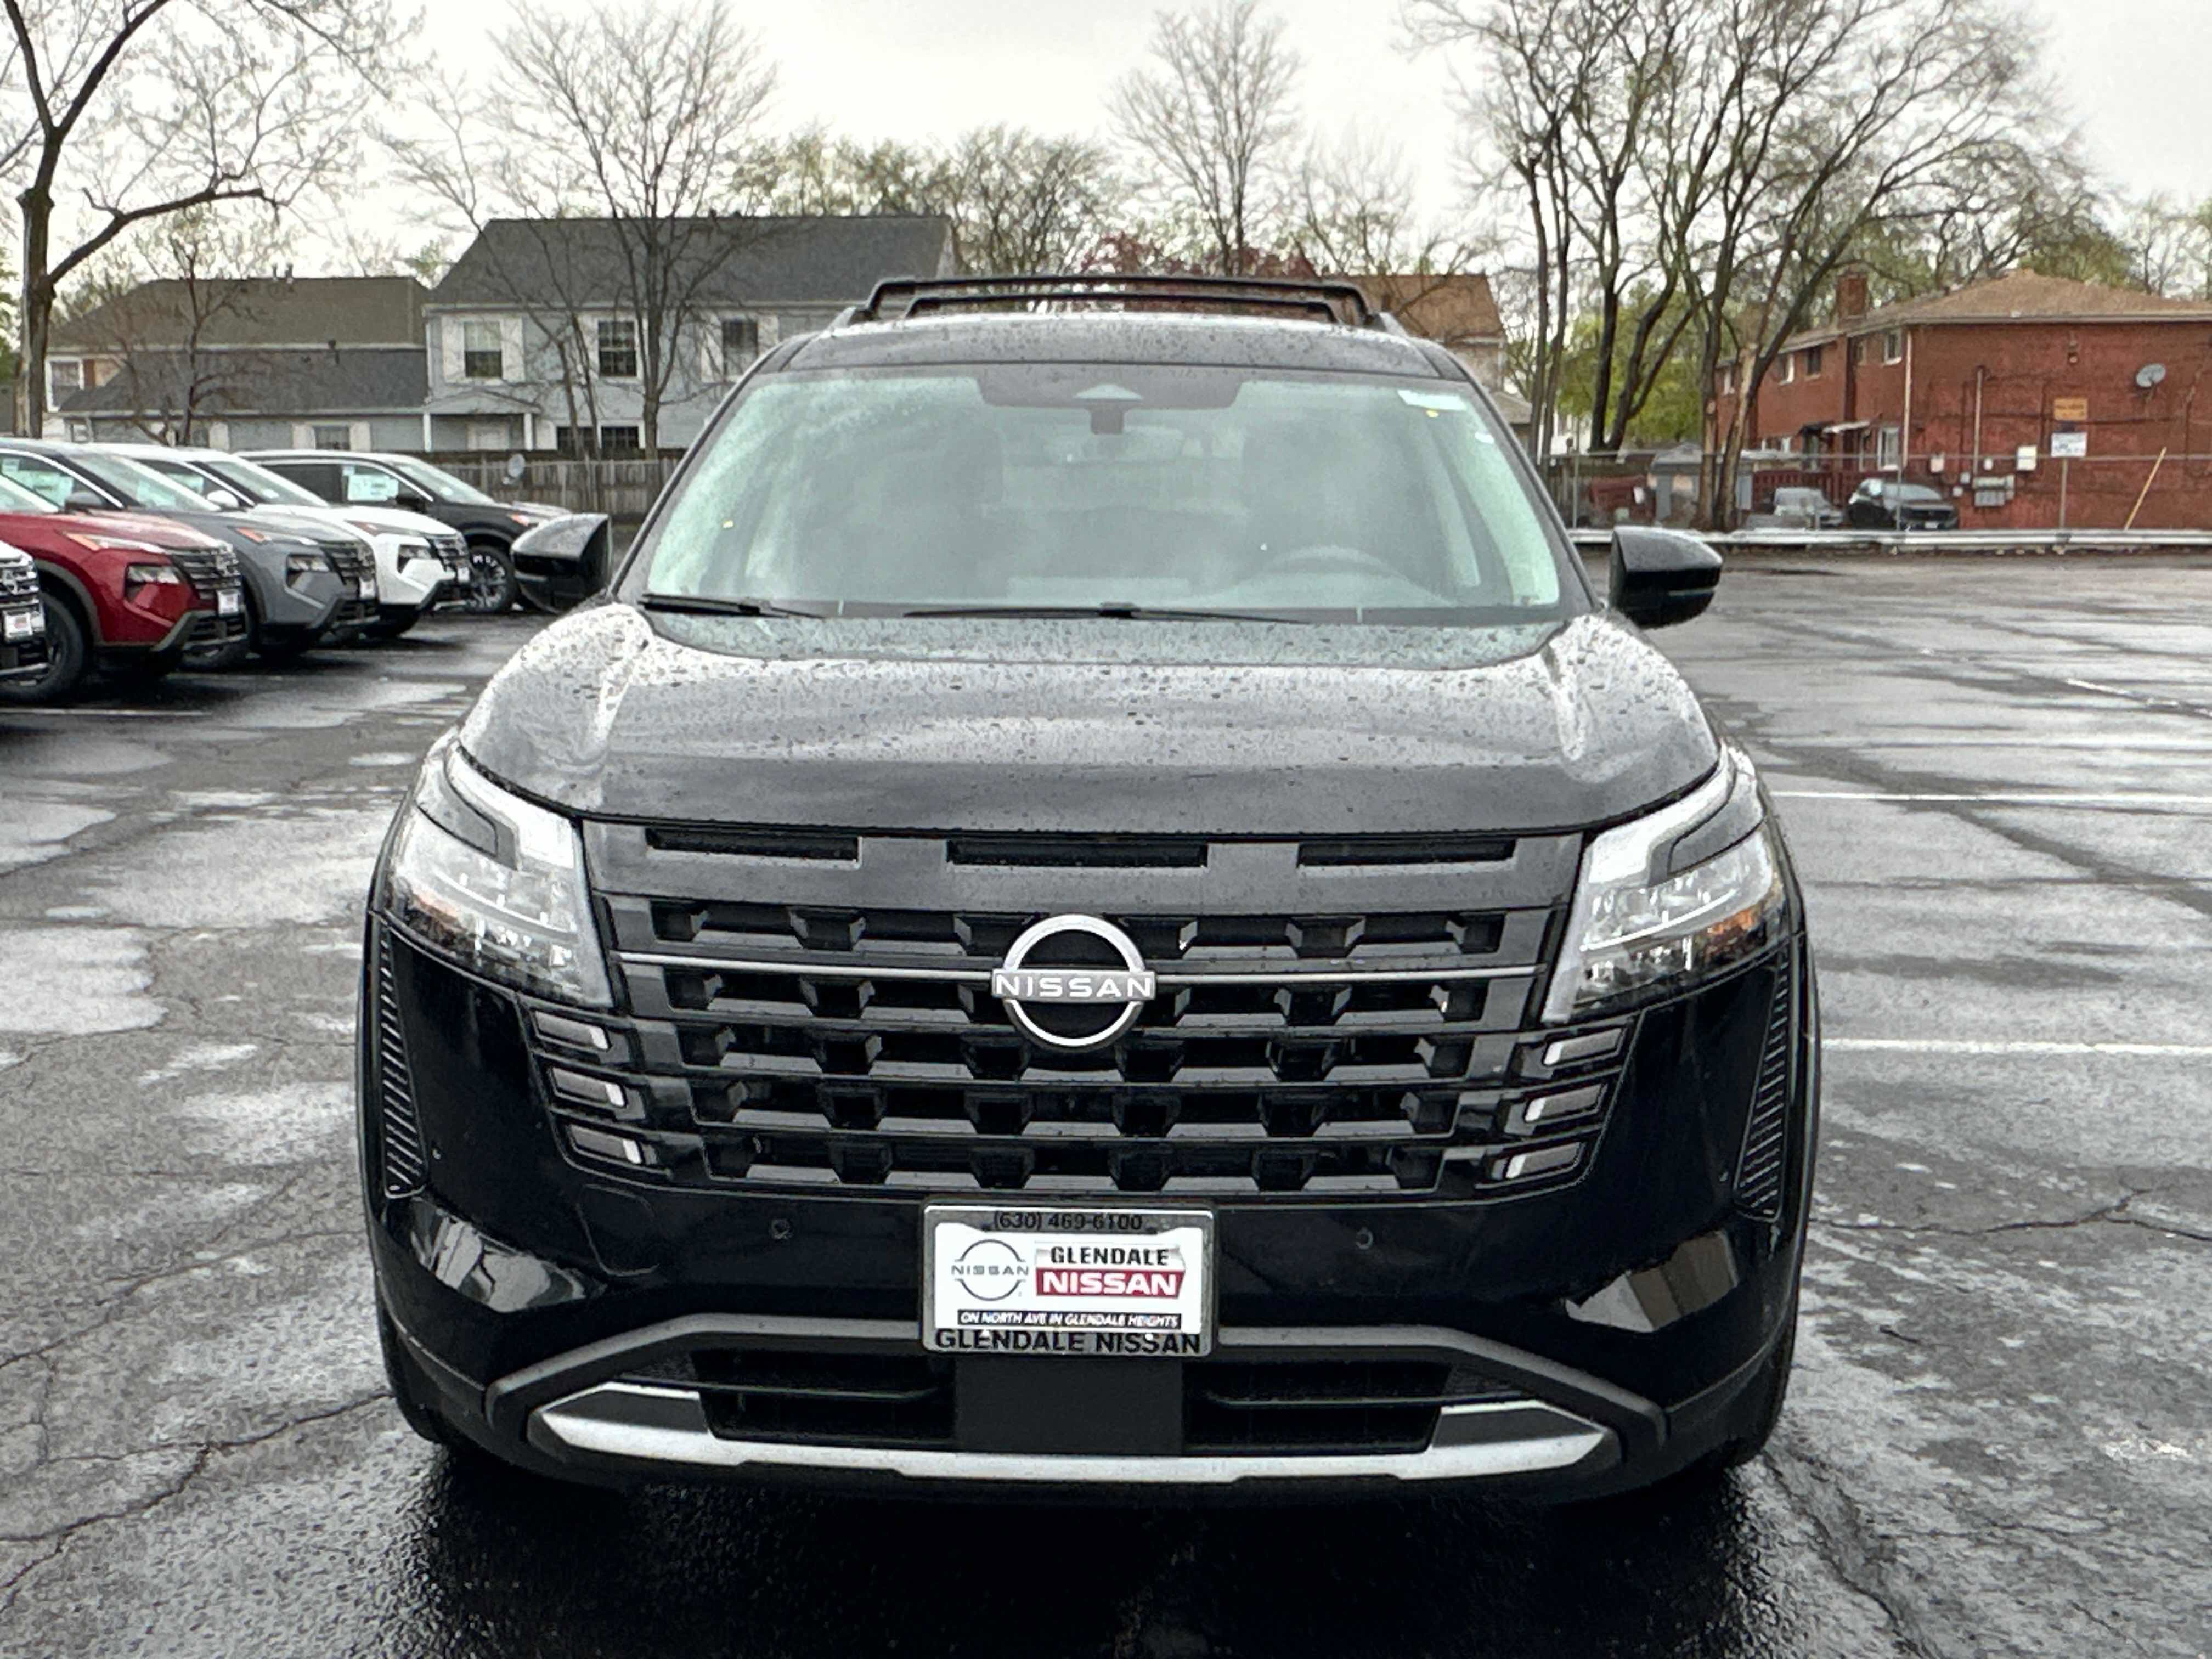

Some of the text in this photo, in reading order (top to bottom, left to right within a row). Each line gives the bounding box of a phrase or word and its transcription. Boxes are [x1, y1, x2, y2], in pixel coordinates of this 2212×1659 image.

[995, 974, 1151, 997] NISSAN
[994, 1210, 1143, 1231] (630) 469-6100
[1050, 1246, 1169, 1266] GLENDALE
[951, 1265, 1029, 1276] NISSAN
[1042, 1272, 1178, 1295] NISSAN
[961, 1312, 980, 1323] ON
[981, 1312, 1023, 1324] NORTH
[1049, 1313, 1063, 1325] IN
[1065, 1313, 1125, 1325] GLENDALE
[1127, 1315, 1178, 1328] HEIGHTS
[935, 1329, 1201, 1355] GLENDALE NISSAN
